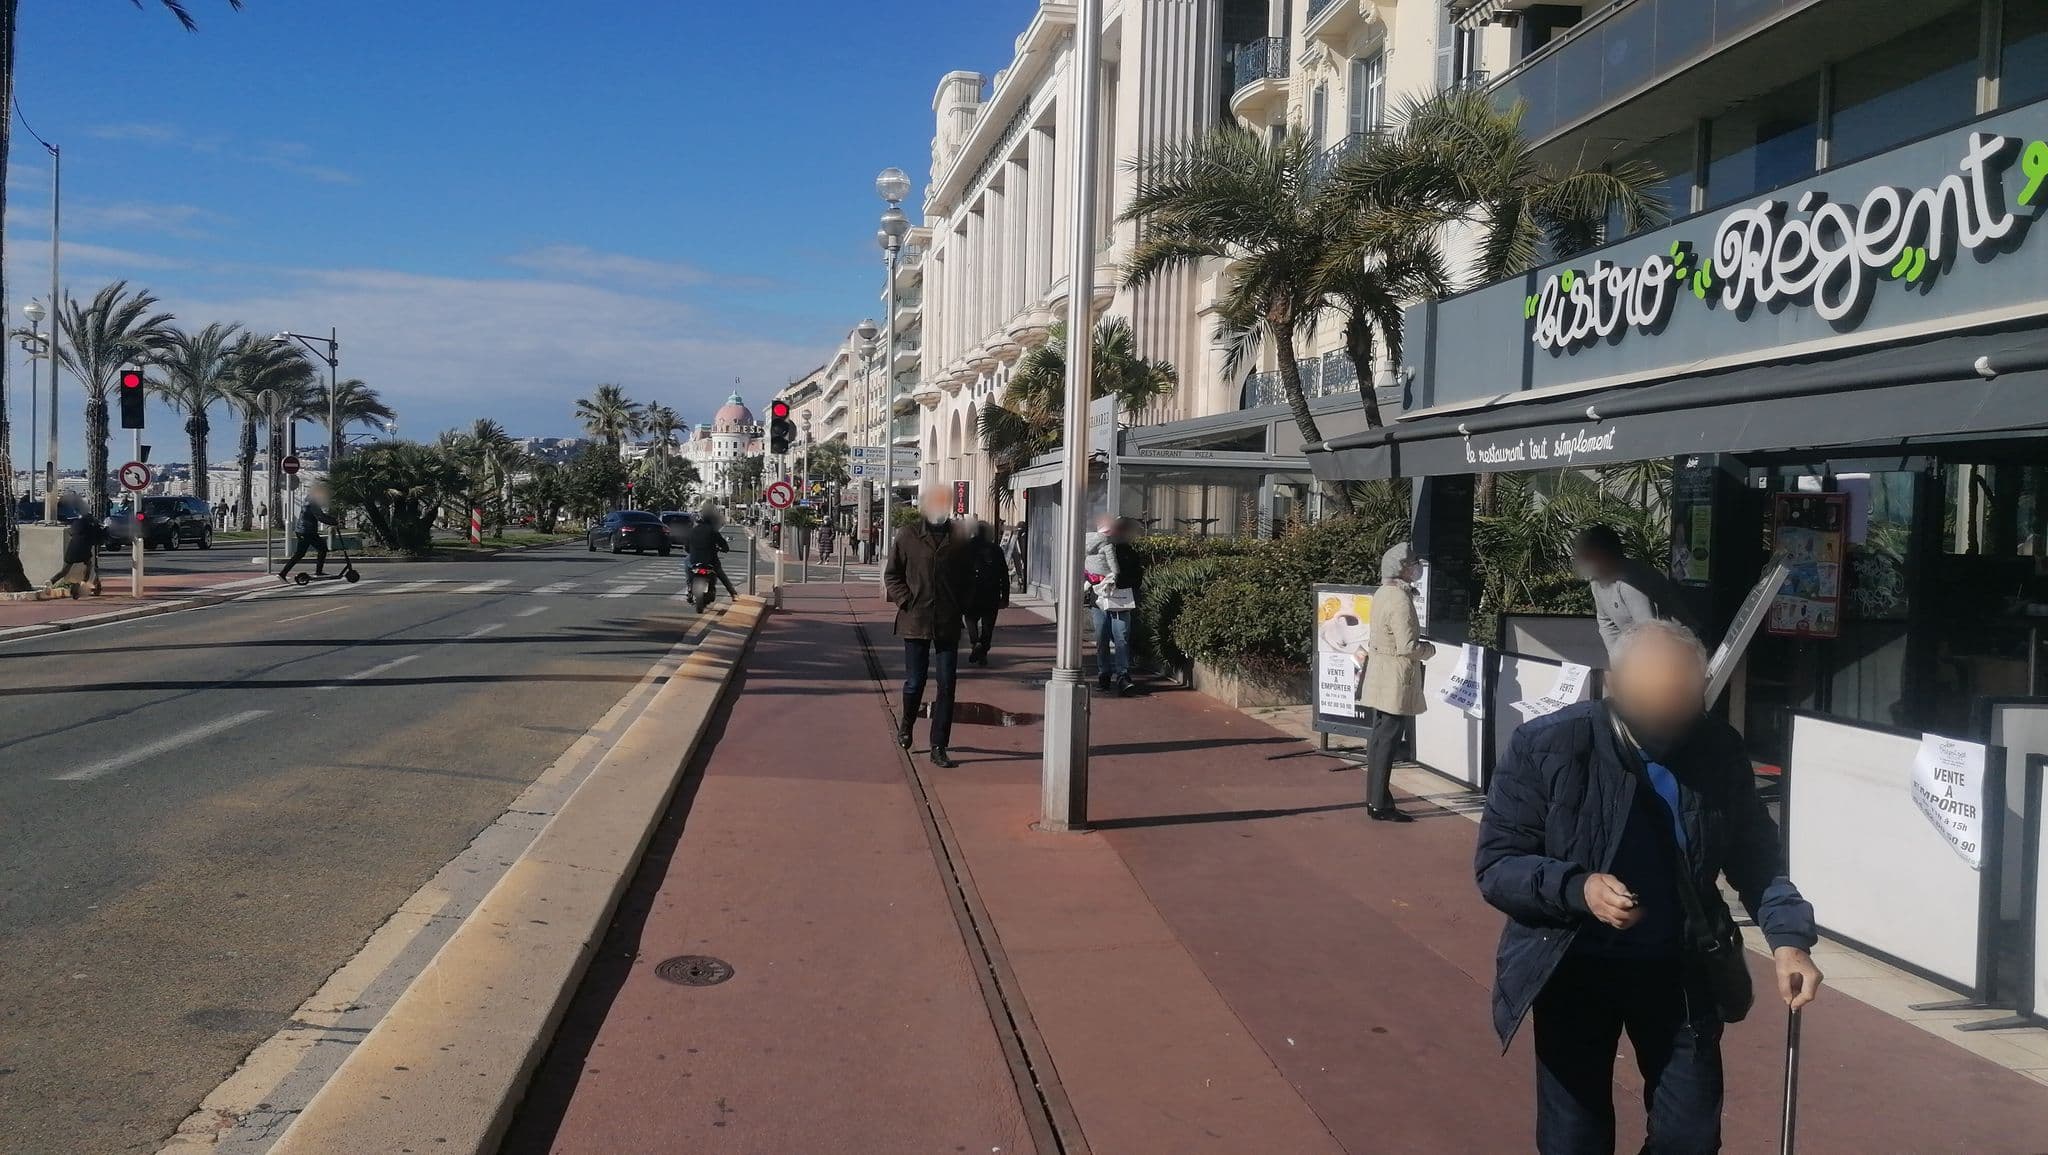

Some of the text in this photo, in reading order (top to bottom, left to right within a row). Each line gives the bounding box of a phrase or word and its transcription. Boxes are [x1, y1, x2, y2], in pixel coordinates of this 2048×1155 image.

[1714, 132, 2014, 320] Régent
[1479, 442, 1525, 464] restaurant
[1529, 437, 1548, 460] tout
[1553, 426, 1616, 462] simplement
[1140, 449, 1183, 458] RESTAURANT
[957, 481, 965, 514] CASINO
[1327, 668, 1345, 677] VENTE
[1321, 682, 1352, 692] EMPORTER
[1934, 767, 1965, 787] VENTE
[1952, 821, 1968, 832] 15h
[1961, 840, 1976, 853] 90
